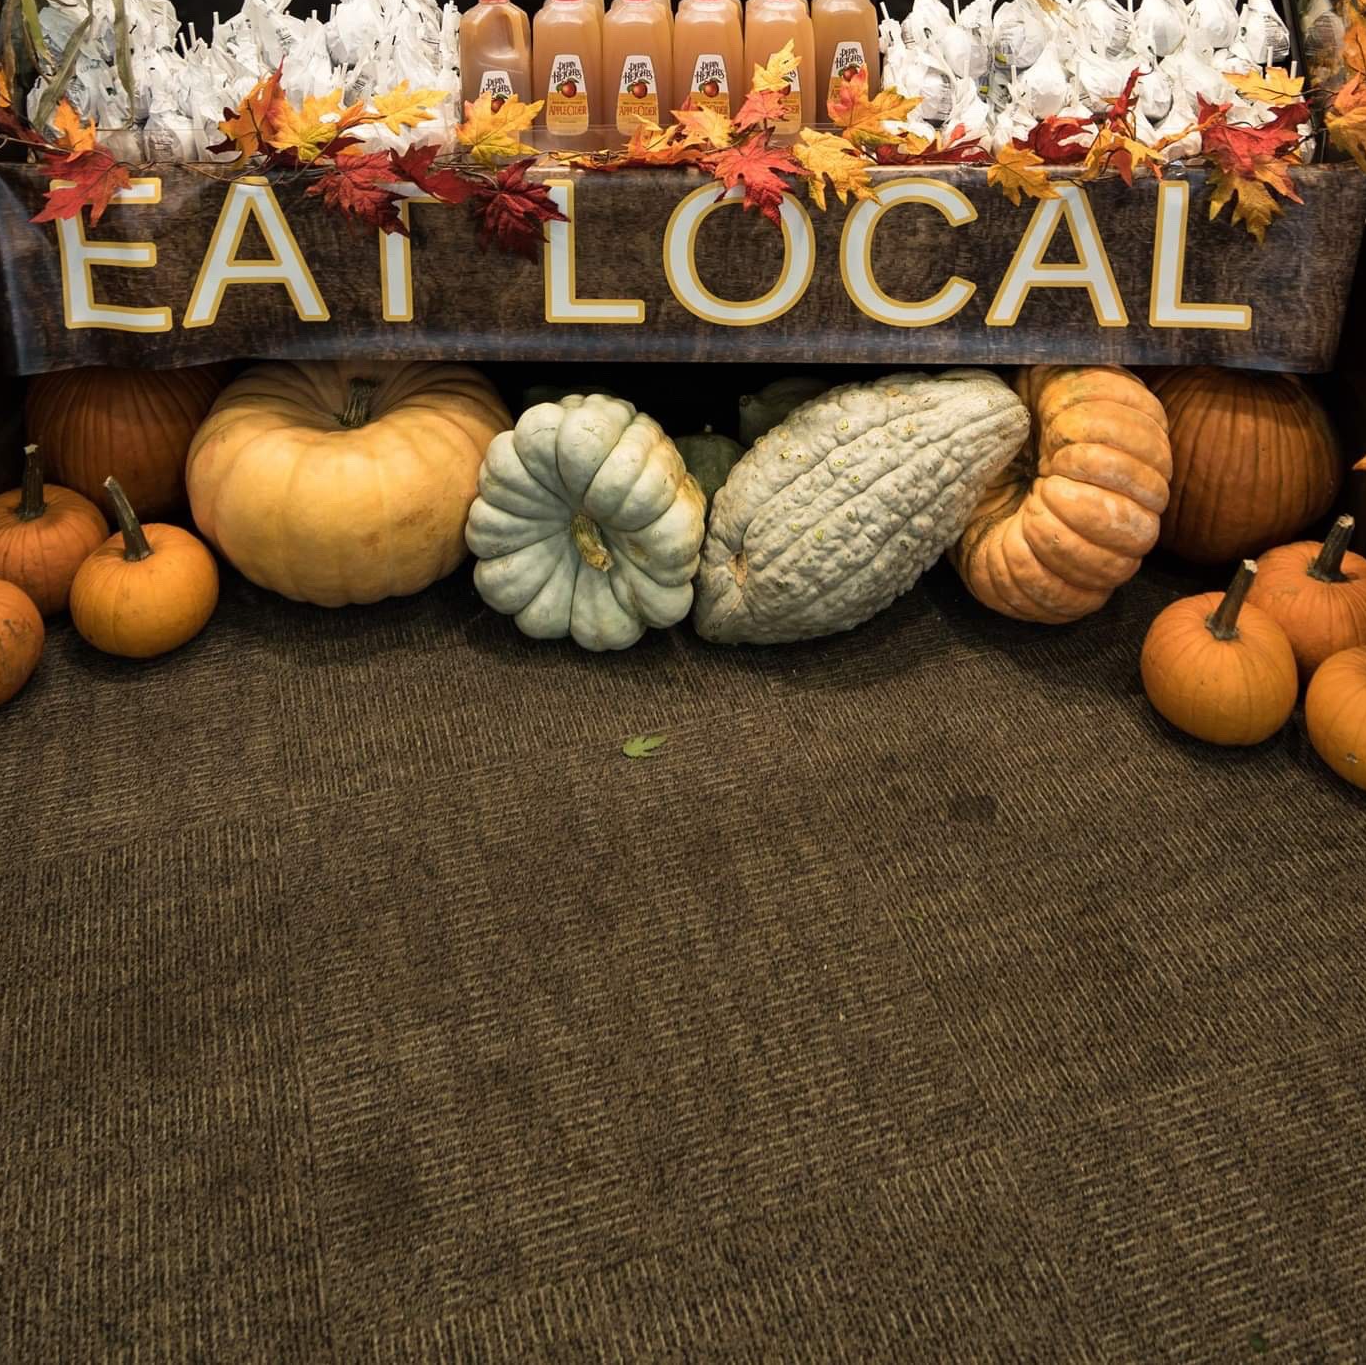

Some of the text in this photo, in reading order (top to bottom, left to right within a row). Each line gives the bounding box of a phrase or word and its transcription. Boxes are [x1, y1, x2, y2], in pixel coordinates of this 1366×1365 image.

[839, 47, 858, 58] PEPIN
[557, 61, 576, 71] PEPIN
[628, 61, 647, 72] PEPIN
[702, 60, 719, 70] PEPIN
[544, 180, 1252, 330] LOCAL
